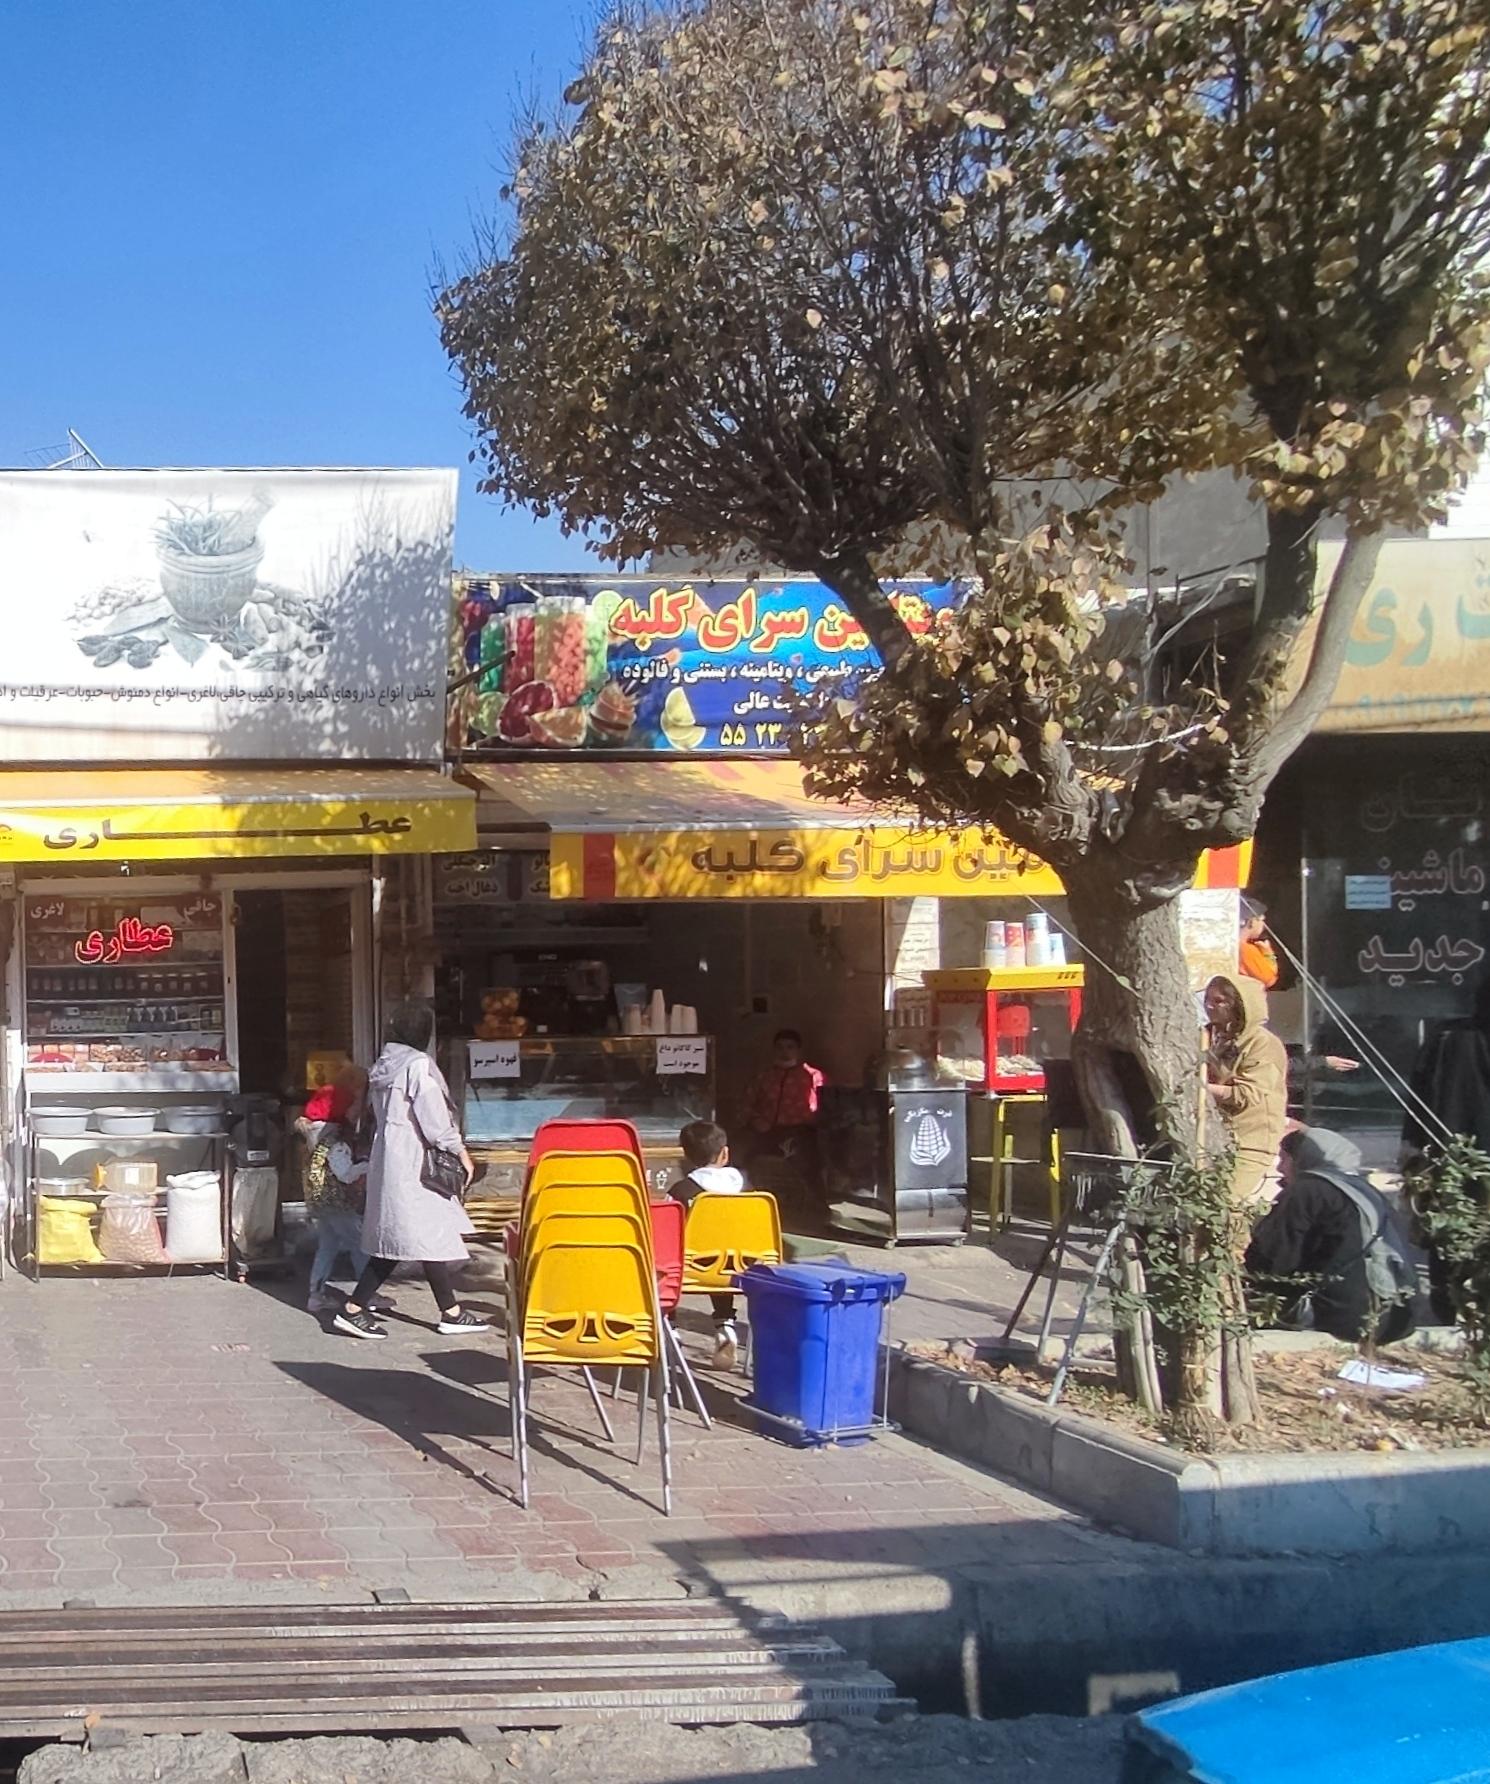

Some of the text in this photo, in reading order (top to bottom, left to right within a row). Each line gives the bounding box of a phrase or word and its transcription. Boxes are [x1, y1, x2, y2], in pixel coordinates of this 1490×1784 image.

[698, 586, 809, 653] سرای
[622, 658, 668, 684] فالوده
[670, 666, 681, 684] و
[684, 662, 727, 684] بستنی
[287, 689, 294, 703] و
[297, 684, 330, 703] گیاهی
[332, 686, 376, 703] داروهای
[378, 684, 404, 707] انواع
[733, 691, 771, 714] عالی
[720, 722, 747, 746] ۵۵
[43, 812, 413, 850] عطاری
[691, 832, 806, 883] کلبه
[820, 837, 942, 884] سرای
[30, 902, 65, 920] لاغری
[74, 917, 173, 965] عطاری
[1358, 933, 1485, 987] جدید
